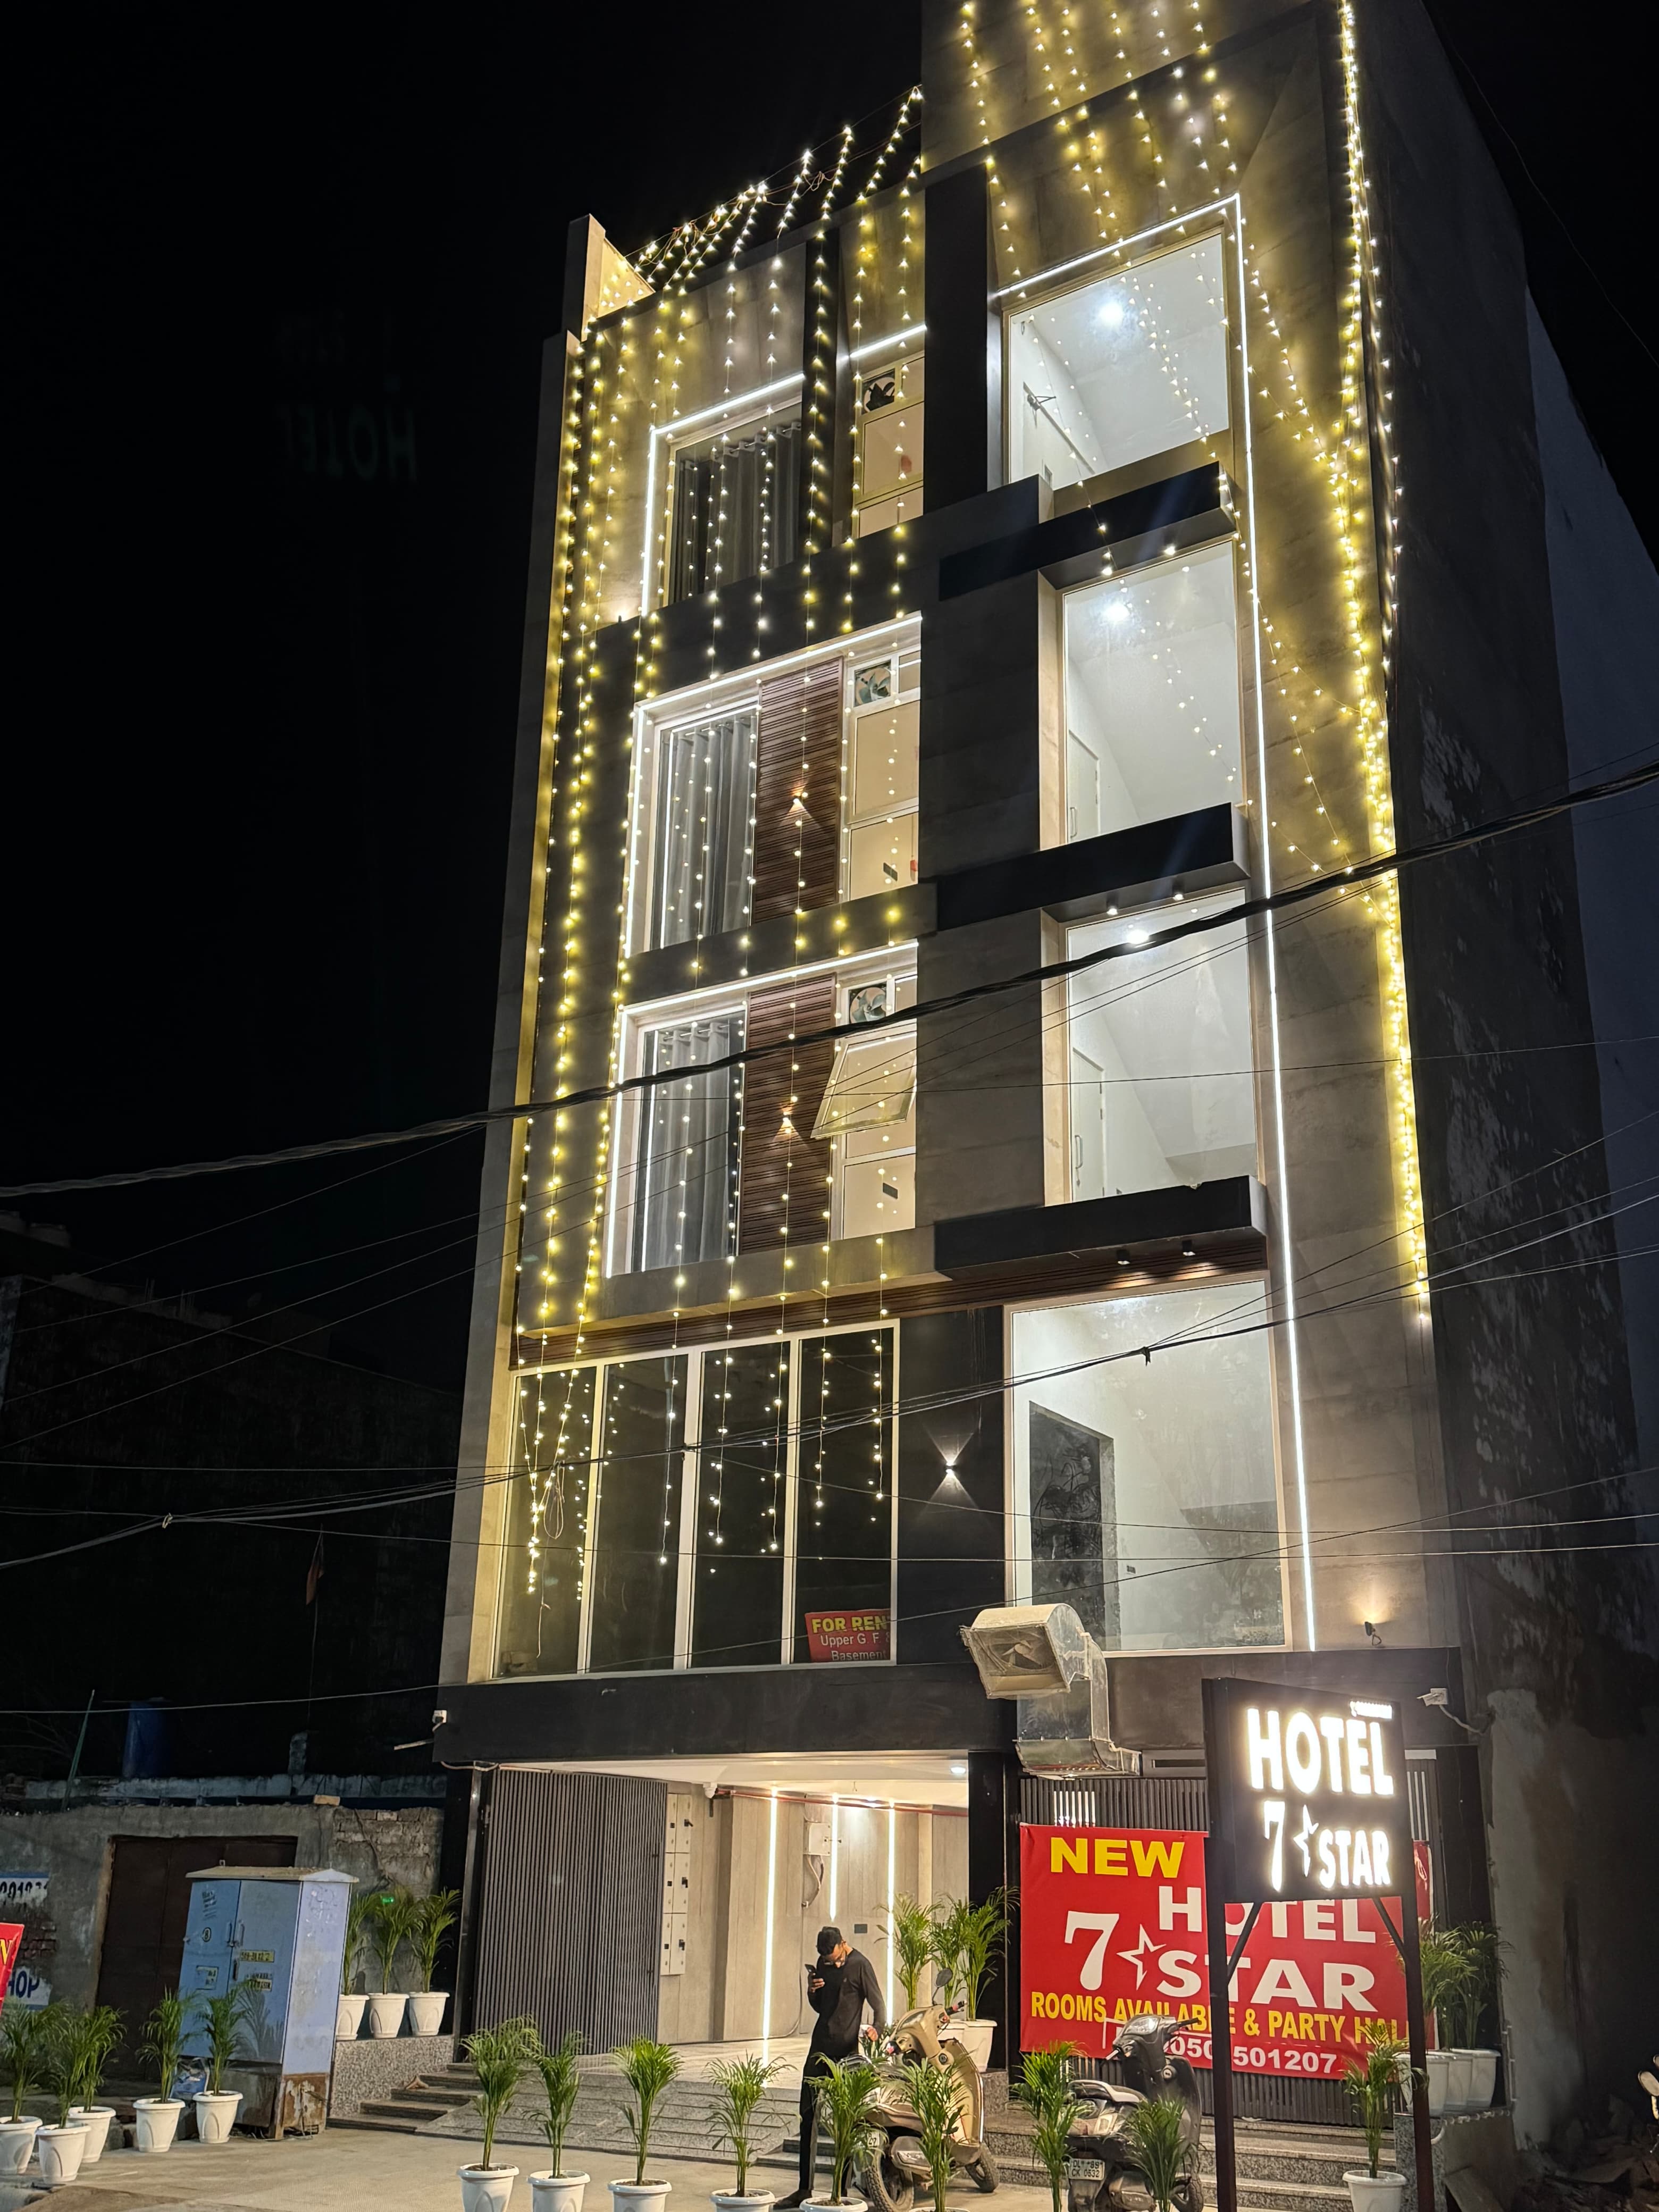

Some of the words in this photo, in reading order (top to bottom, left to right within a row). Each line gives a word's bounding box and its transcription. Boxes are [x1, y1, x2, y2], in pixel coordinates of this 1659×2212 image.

[811, 1618, 847, 1634] FOR
[851, 1616, 890, 1631] REN
[820, 1635, 854, 1648] Upper
[831, 1650, 887, 1661] Basement
[1247, 1707, 1394, 1795] HOTEL
[1050, 1837, 1185, 1879] NEW
[1263, 1800, 1286, 1892] 7
[1319, 1828, 1391, 1889] STAR
[1064, 1911, 1120, 1991] 7
[1031, 1991, 1107, 2023] ROOMS
[1244, 2008, 1260, 2037] &
[1268, 2010, 1346, 2043] PARTY
[1354, 2016, 1410, 2048] HAL
[1233, 2046, 1337, 2073] 501207
